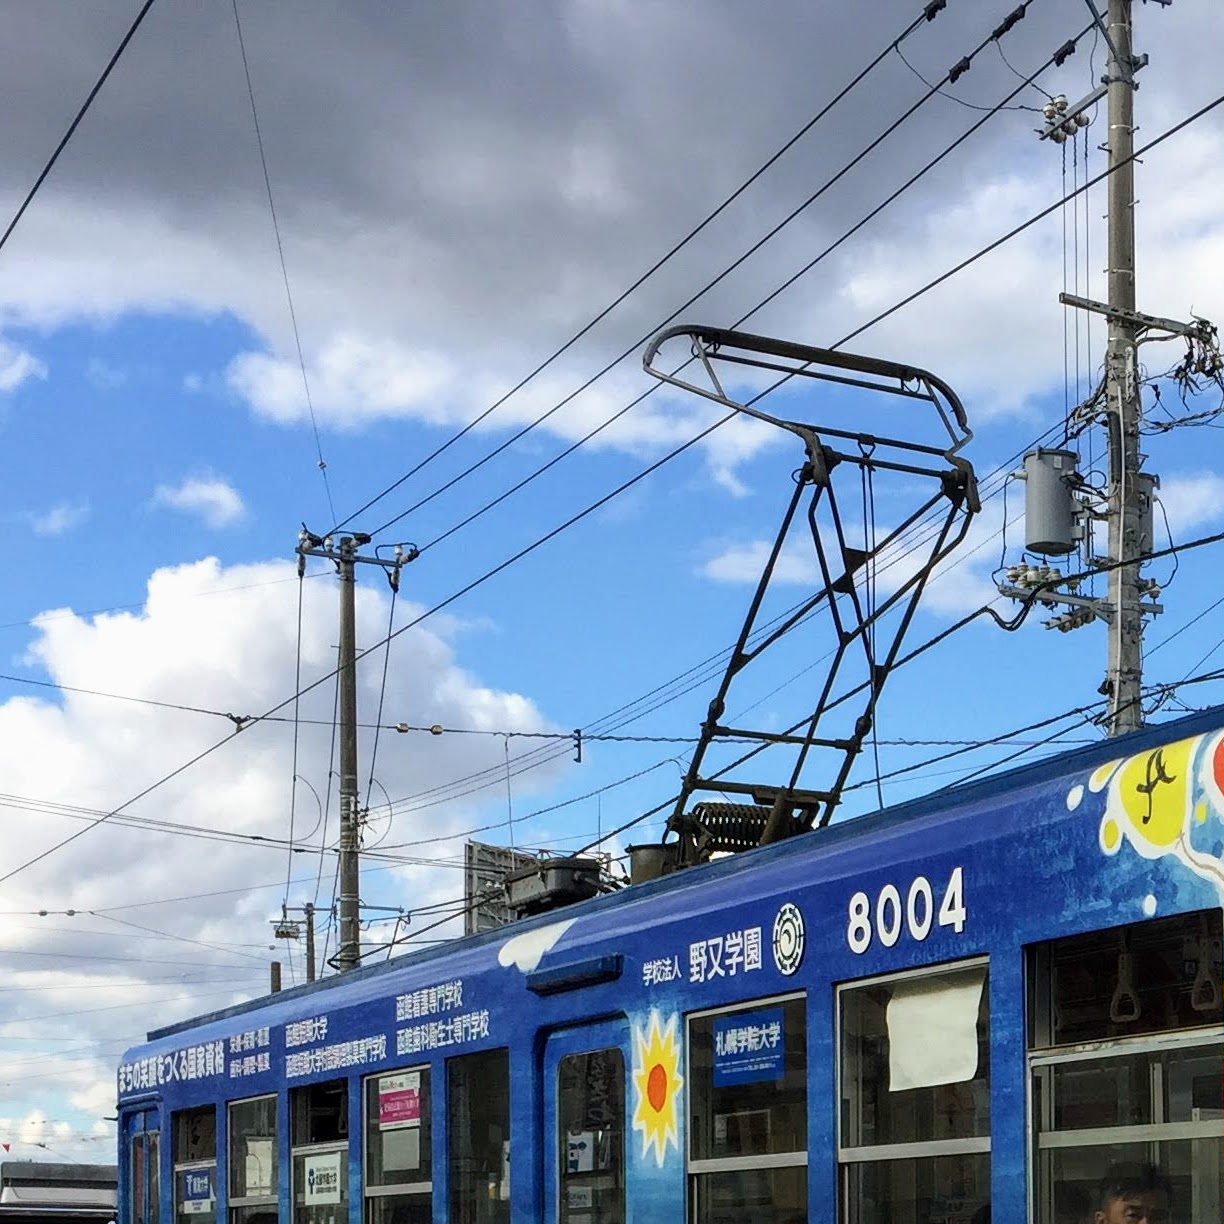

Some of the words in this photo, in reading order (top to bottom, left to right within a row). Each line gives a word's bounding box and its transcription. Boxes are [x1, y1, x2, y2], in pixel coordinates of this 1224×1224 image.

[1136, 748, 1177, 825] A
[846, 867, 967, 955] 8004
[642, 955, 683, 987] 学校法人
[688, 926, 763, 985] 野又学園
